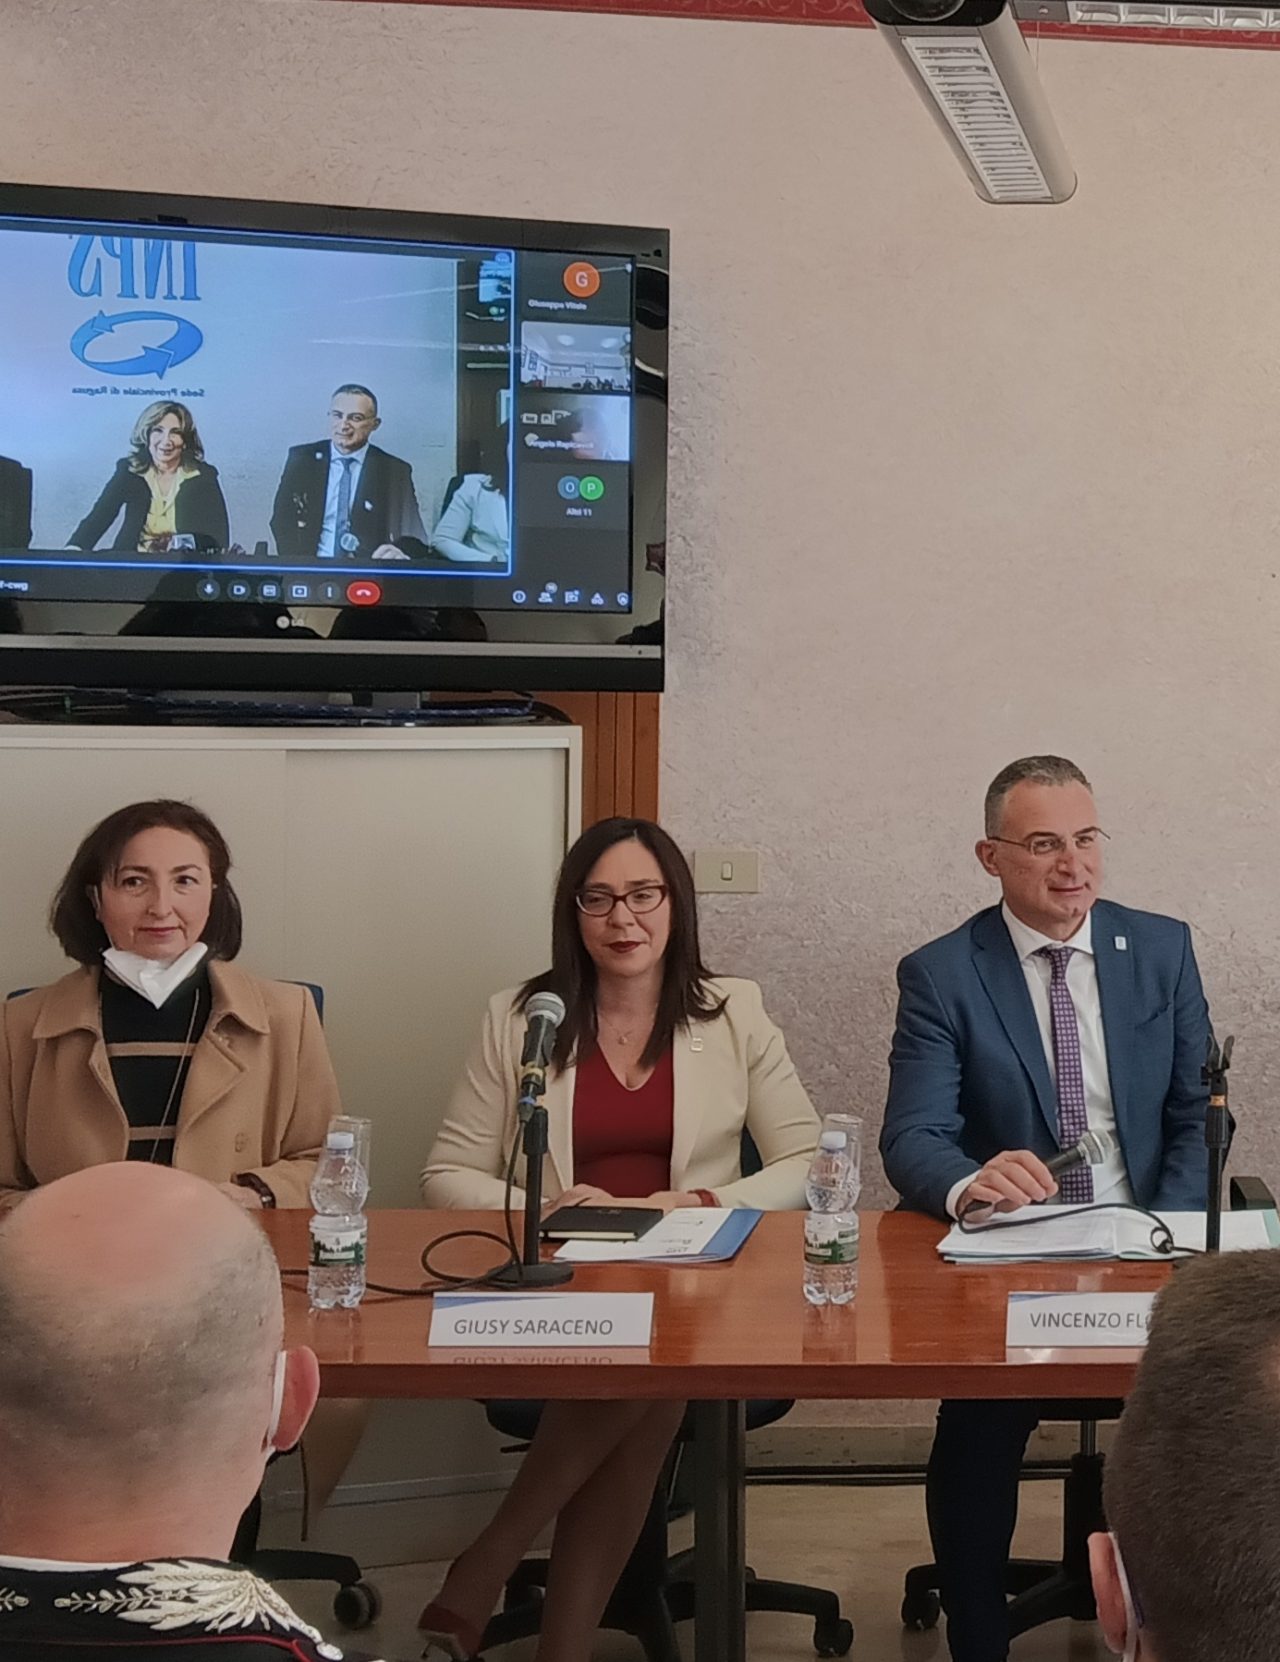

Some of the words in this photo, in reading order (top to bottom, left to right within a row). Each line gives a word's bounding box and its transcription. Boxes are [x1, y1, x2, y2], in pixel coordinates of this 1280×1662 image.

[575, 271, 589, 288] G
[587, 482, 596, 493] P
[453, 1319, 510, 1335] GIUSY
[513, 1319, 614, 1336] SARACENO
[1029, 1312, 1121, 1328] VINCENZO
